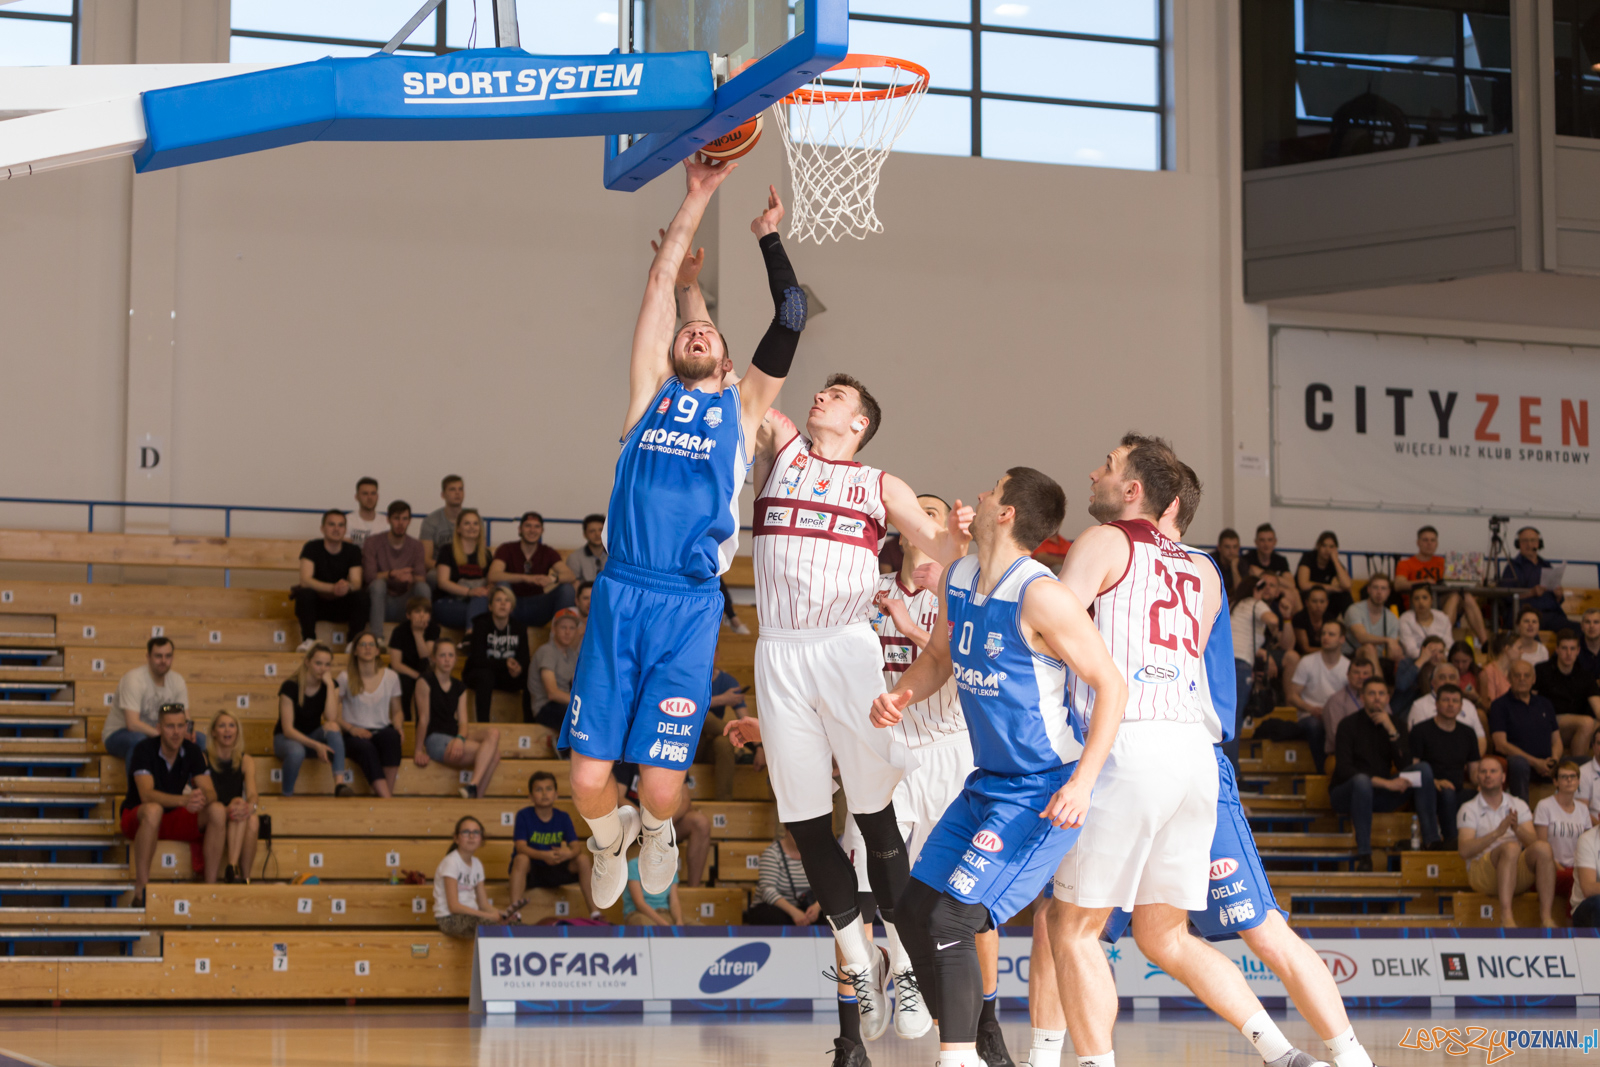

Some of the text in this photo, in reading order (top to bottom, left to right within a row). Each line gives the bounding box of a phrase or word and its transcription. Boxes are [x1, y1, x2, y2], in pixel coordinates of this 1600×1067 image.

[404, 63, 644, 97] SPORT SYSTEM
[674, 394, 699, 423] 9
[1305, 383, 1590, 447] CITYZEN
[139, 446, 160, 469] D
[1394, 442, 1442, 457] WIĘCEJ
[1478, 446, 1512, 460] KLUB
[1519, 448, 1591, 465] SPORTOWY
[847, 486, 866, 504] 10
[767, 511, 785, 521] PEC
[1149, 558, 1201, 659] 25
[571, 694, 582, 727] 9
[665, 701, 691, 713] KIA
[656, 722, 693, 736] DELIK
[660, 743, 689, 763] PBG
[974, 832, 997, 850] KIA
[1209, 861, 1234, 878] KIA
[1211, 879, 1248, 900] DELIK
[1226, 902, 1256, 925] PBG
[491, 951, 638, 977] BIOFARM
[709, 960, 758, 977] atrem
[1372, 957, 1431, 977] DELIK
[1477, 955, 1576, 979] NICKEL
[504, 980, 535, 988] POLSKI
[540, 980, 593, 988] PRODUCENT
